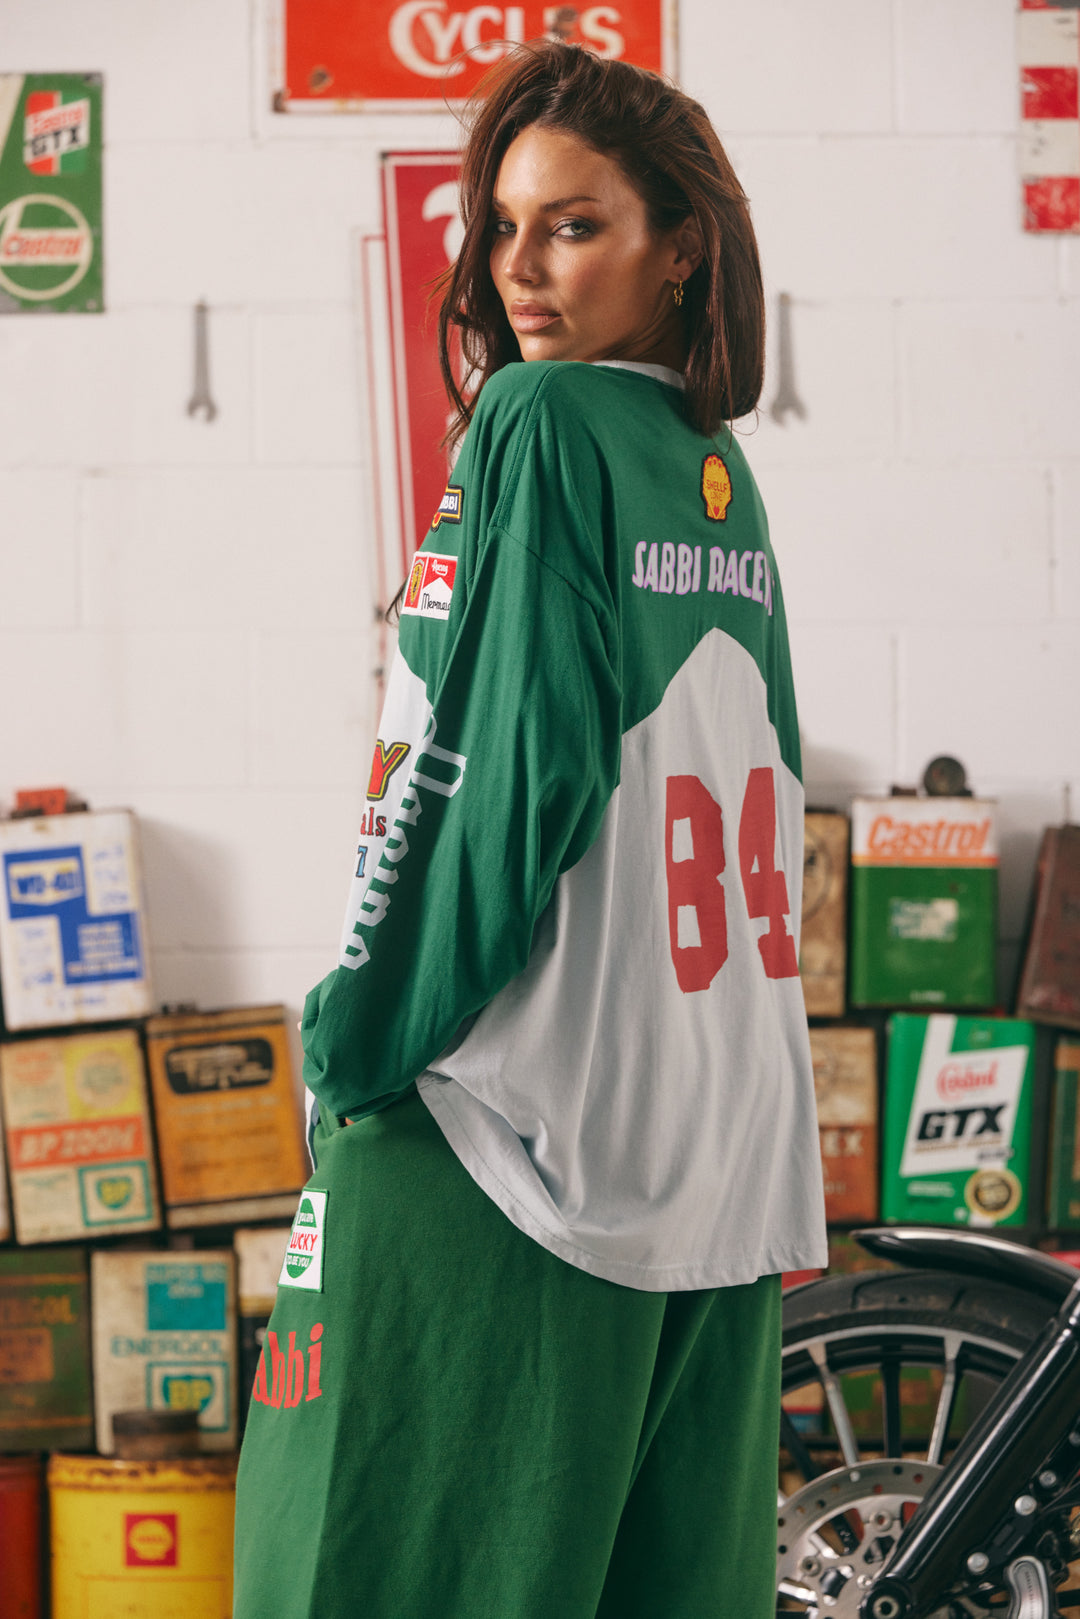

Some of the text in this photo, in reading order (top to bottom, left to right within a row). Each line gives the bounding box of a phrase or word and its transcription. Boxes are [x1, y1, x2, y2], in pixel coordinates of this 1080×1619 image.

[632, 541, 701, 595] SABBI
[867, 815, 991, 855] Castrol
[917, 1102, 1007, 1141] GTX
[290, 1231, 318, 1252] LUCKY
